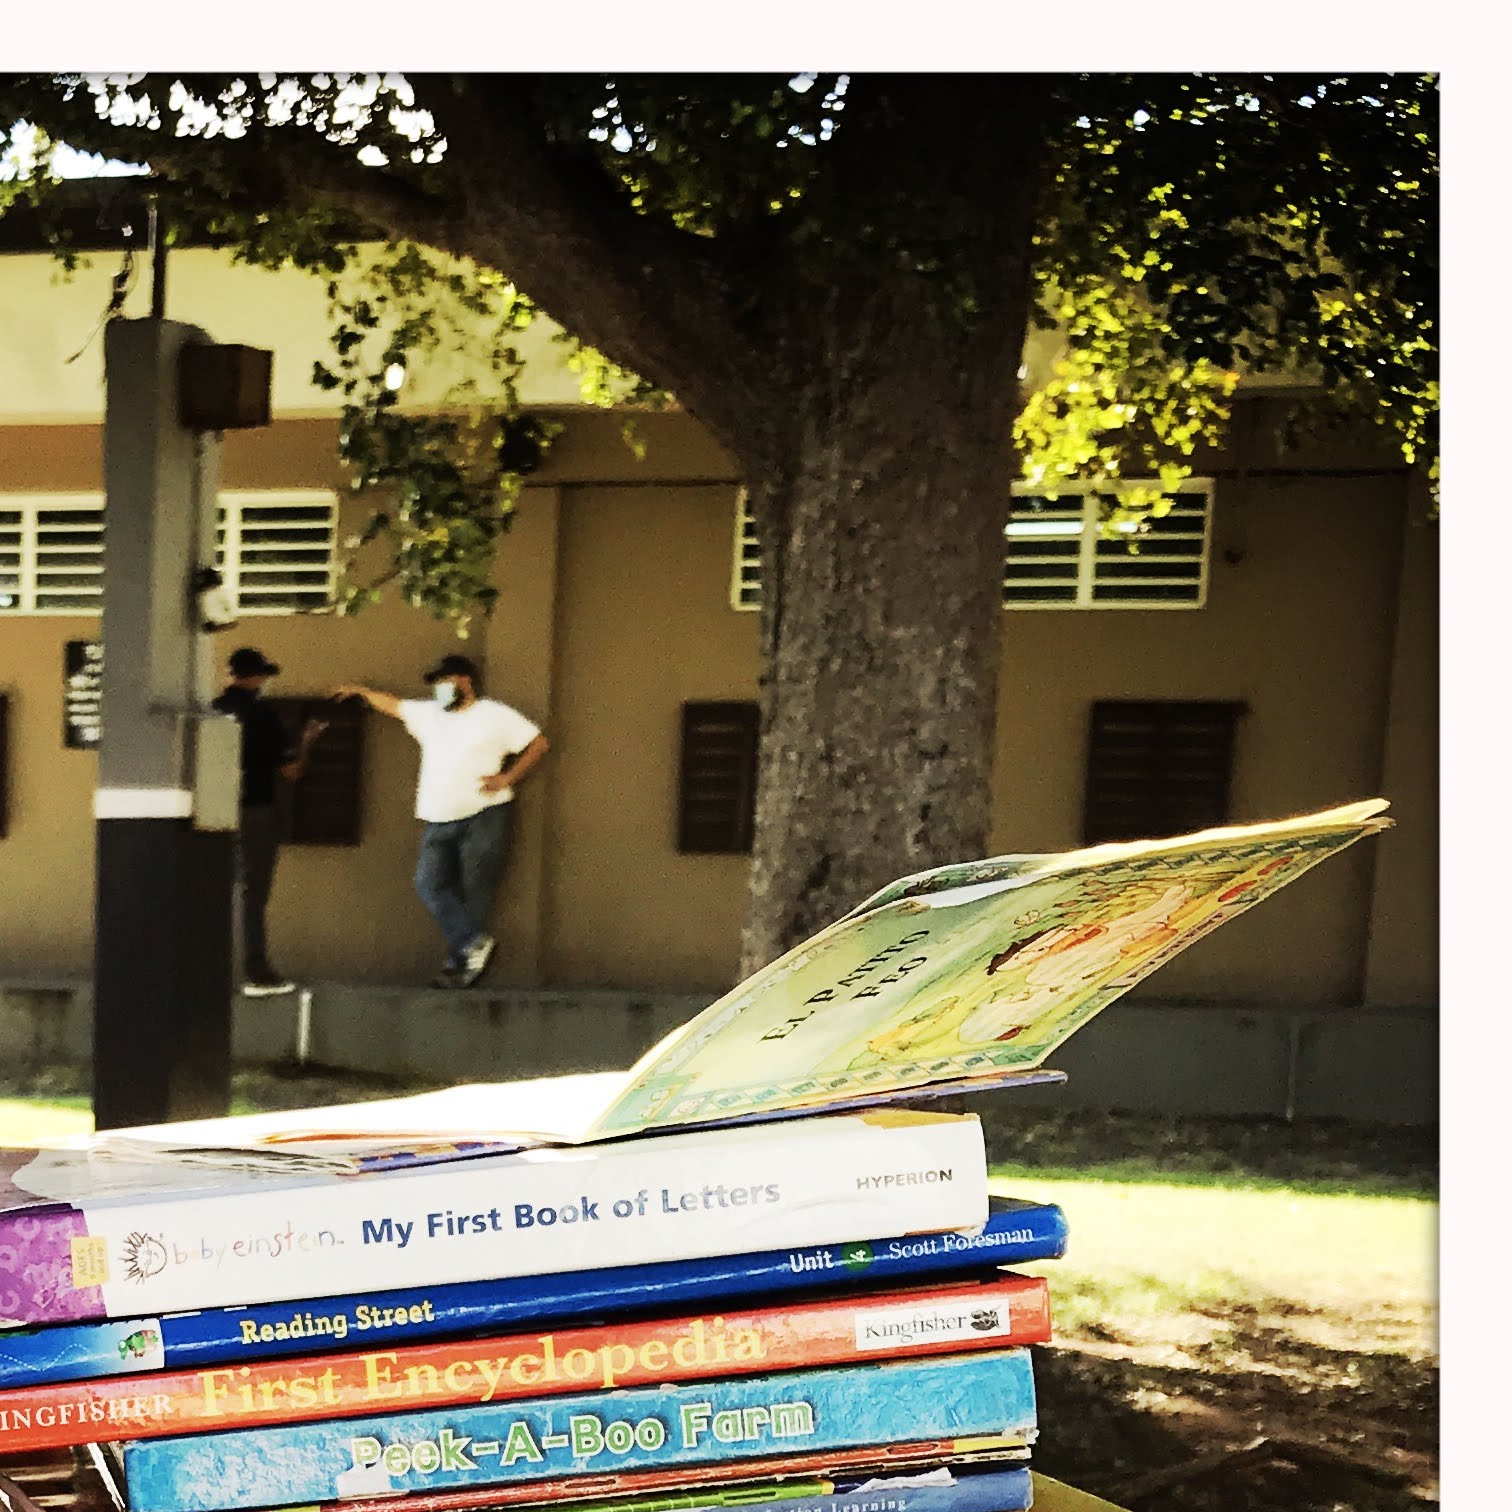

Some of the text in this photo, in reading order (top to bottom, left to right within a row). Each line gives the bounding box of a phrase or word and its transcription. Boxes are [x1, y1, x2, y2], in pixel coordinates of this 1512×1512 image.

[757, 930, 930, 1044] EL PATITO
[850, 957, 927, 1000] FEO
[361, 1215, 414, 1253] My
[427, 1207, 503, 1240] First
[514, 1194, 600, 1229] Book
[613, 1187, 650, 1219] of
[660, 1177, 782, 1214] Letters
[855, 1167, 954, 1192] HYPERION
[240, 1227, 1035, 1346] Reading Street Unit Scott Foresman
[196, 1362, 345, 1417] First
[358, 1315, 768, 1402] Encyclopedia
[864, 1310, 968, 1345] Kingfisher
[350, 1397, 816, 1478] Peek-A-Boo Farm
